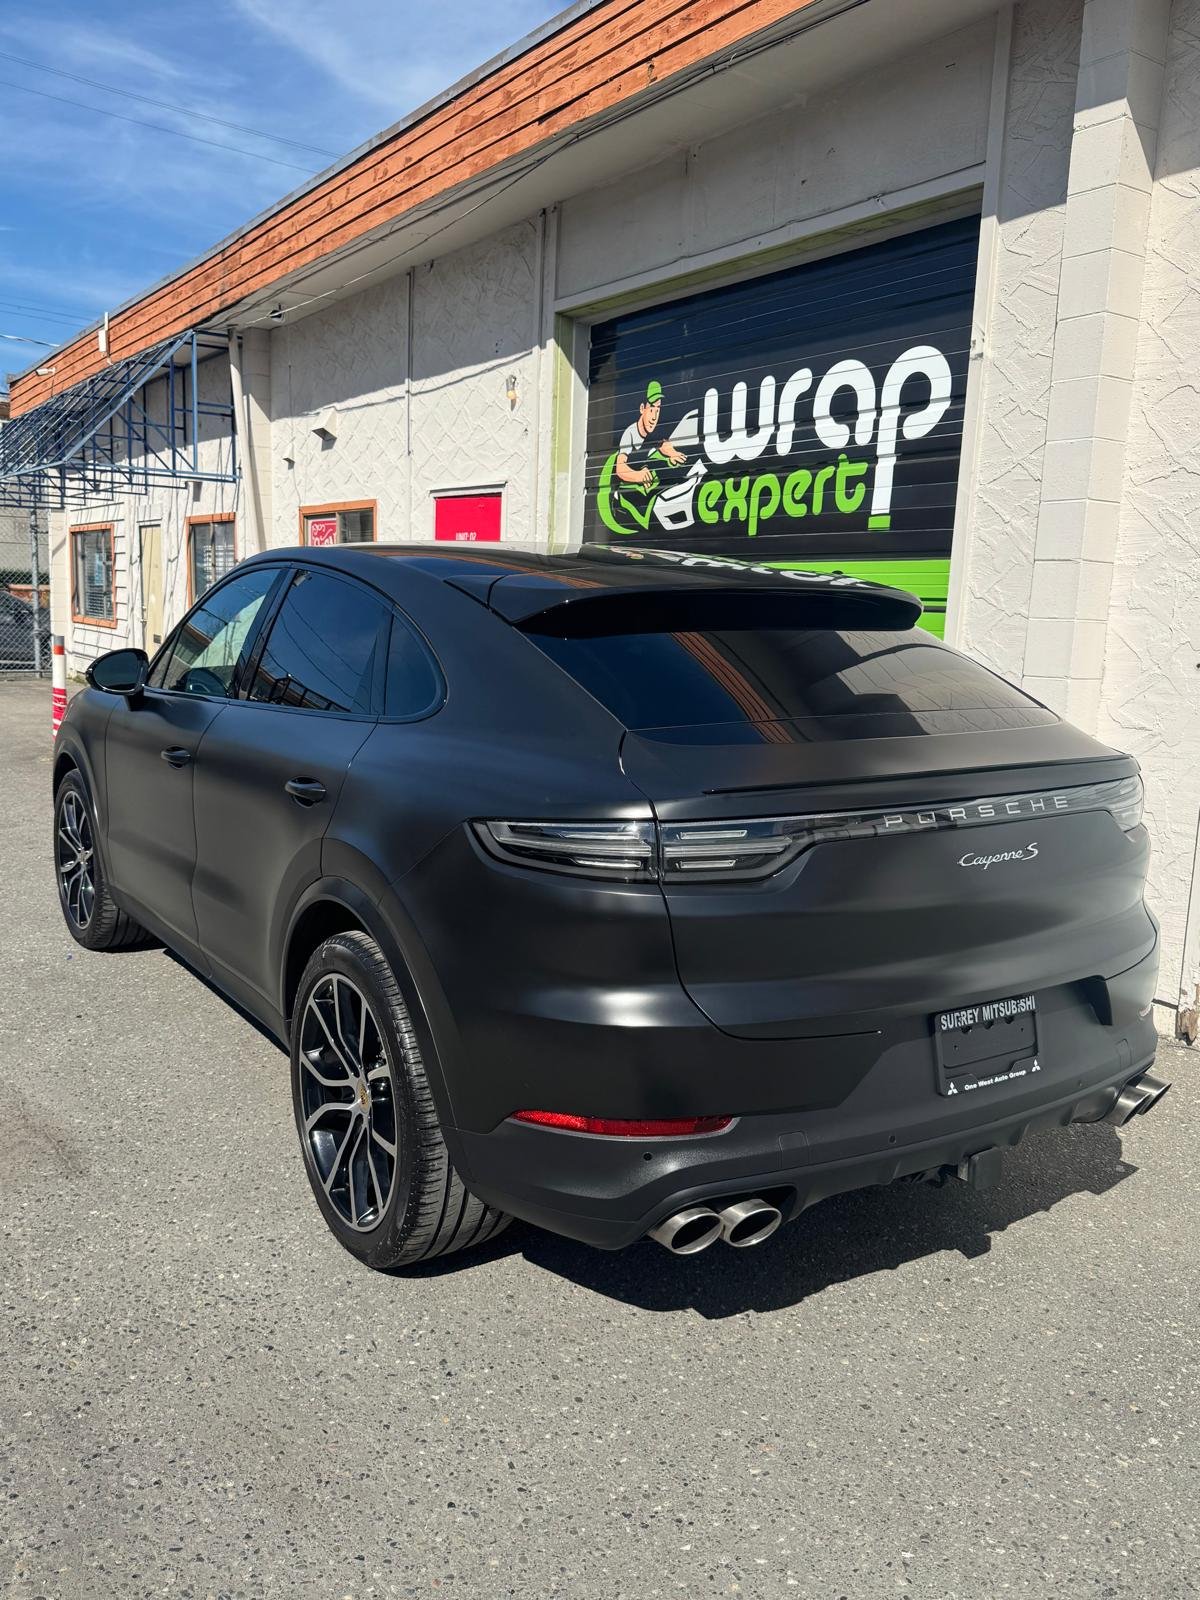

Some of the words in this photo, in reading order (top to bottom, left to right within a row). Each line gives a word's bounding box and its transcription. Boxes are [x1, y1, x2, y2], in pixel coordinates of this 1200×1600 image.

[703, 345, 952, 531] wrap
[697, 453, 869, 537] expert
[883, 796, 1069, 828] PORSCHE
[957, 850, 1023, 870] Cayenne
[1021, 842, 1039, 861] S
[940, 1007, 980, 1031] SURREY
[964, 1083, 977, 1091] One
[978, 1078, 993, 1087] West
[994, 1074, 1008, 1083] Auto
[1009, 1069, 1027, 1079] Group
